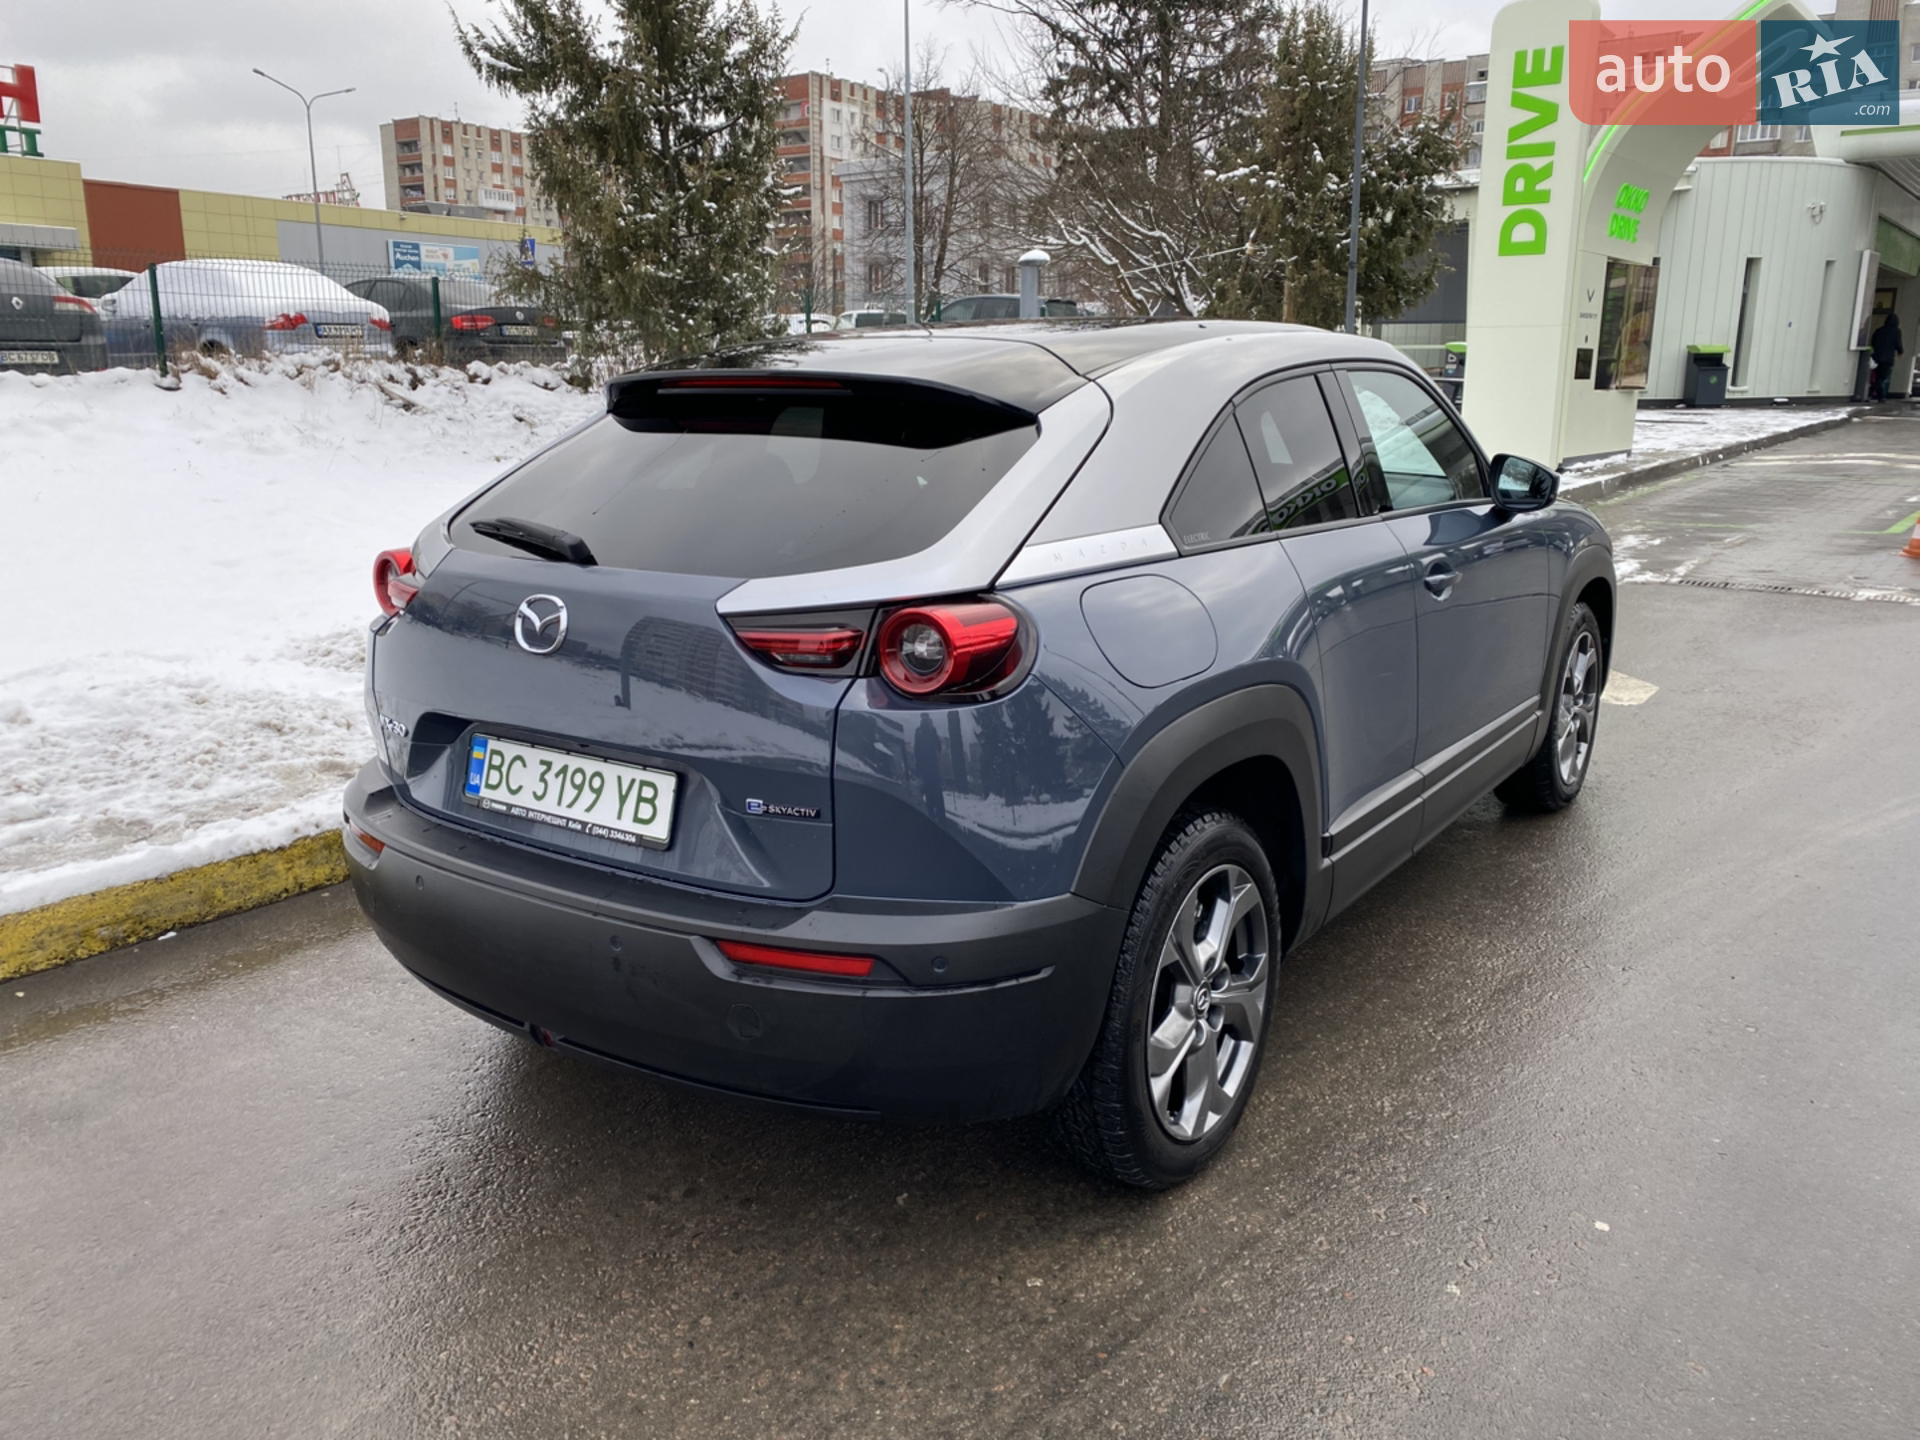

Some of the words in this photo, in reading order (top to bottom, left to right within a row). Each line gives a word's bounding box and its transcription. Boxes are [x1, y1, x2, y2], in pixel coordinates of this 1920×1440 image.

[1498, 45, 1565, 257] DRIVE
[1615, 181, 1650, 214] OKKO
[1607, 211, 1641, 244] DRIVE
[395, 251, 420, 261] Auchan
[1052, 538, 1148, 562] MAZDA
[1183, 531, 1210, 545] ELECTRIC
[469, 773, 480, 786] UA
[484, 748, 527, 796] BC
[532, 759, 605, 813] 3199
[616, 774, 659, 826] YB
[768, 804, 817, 817] SKYACTIV
